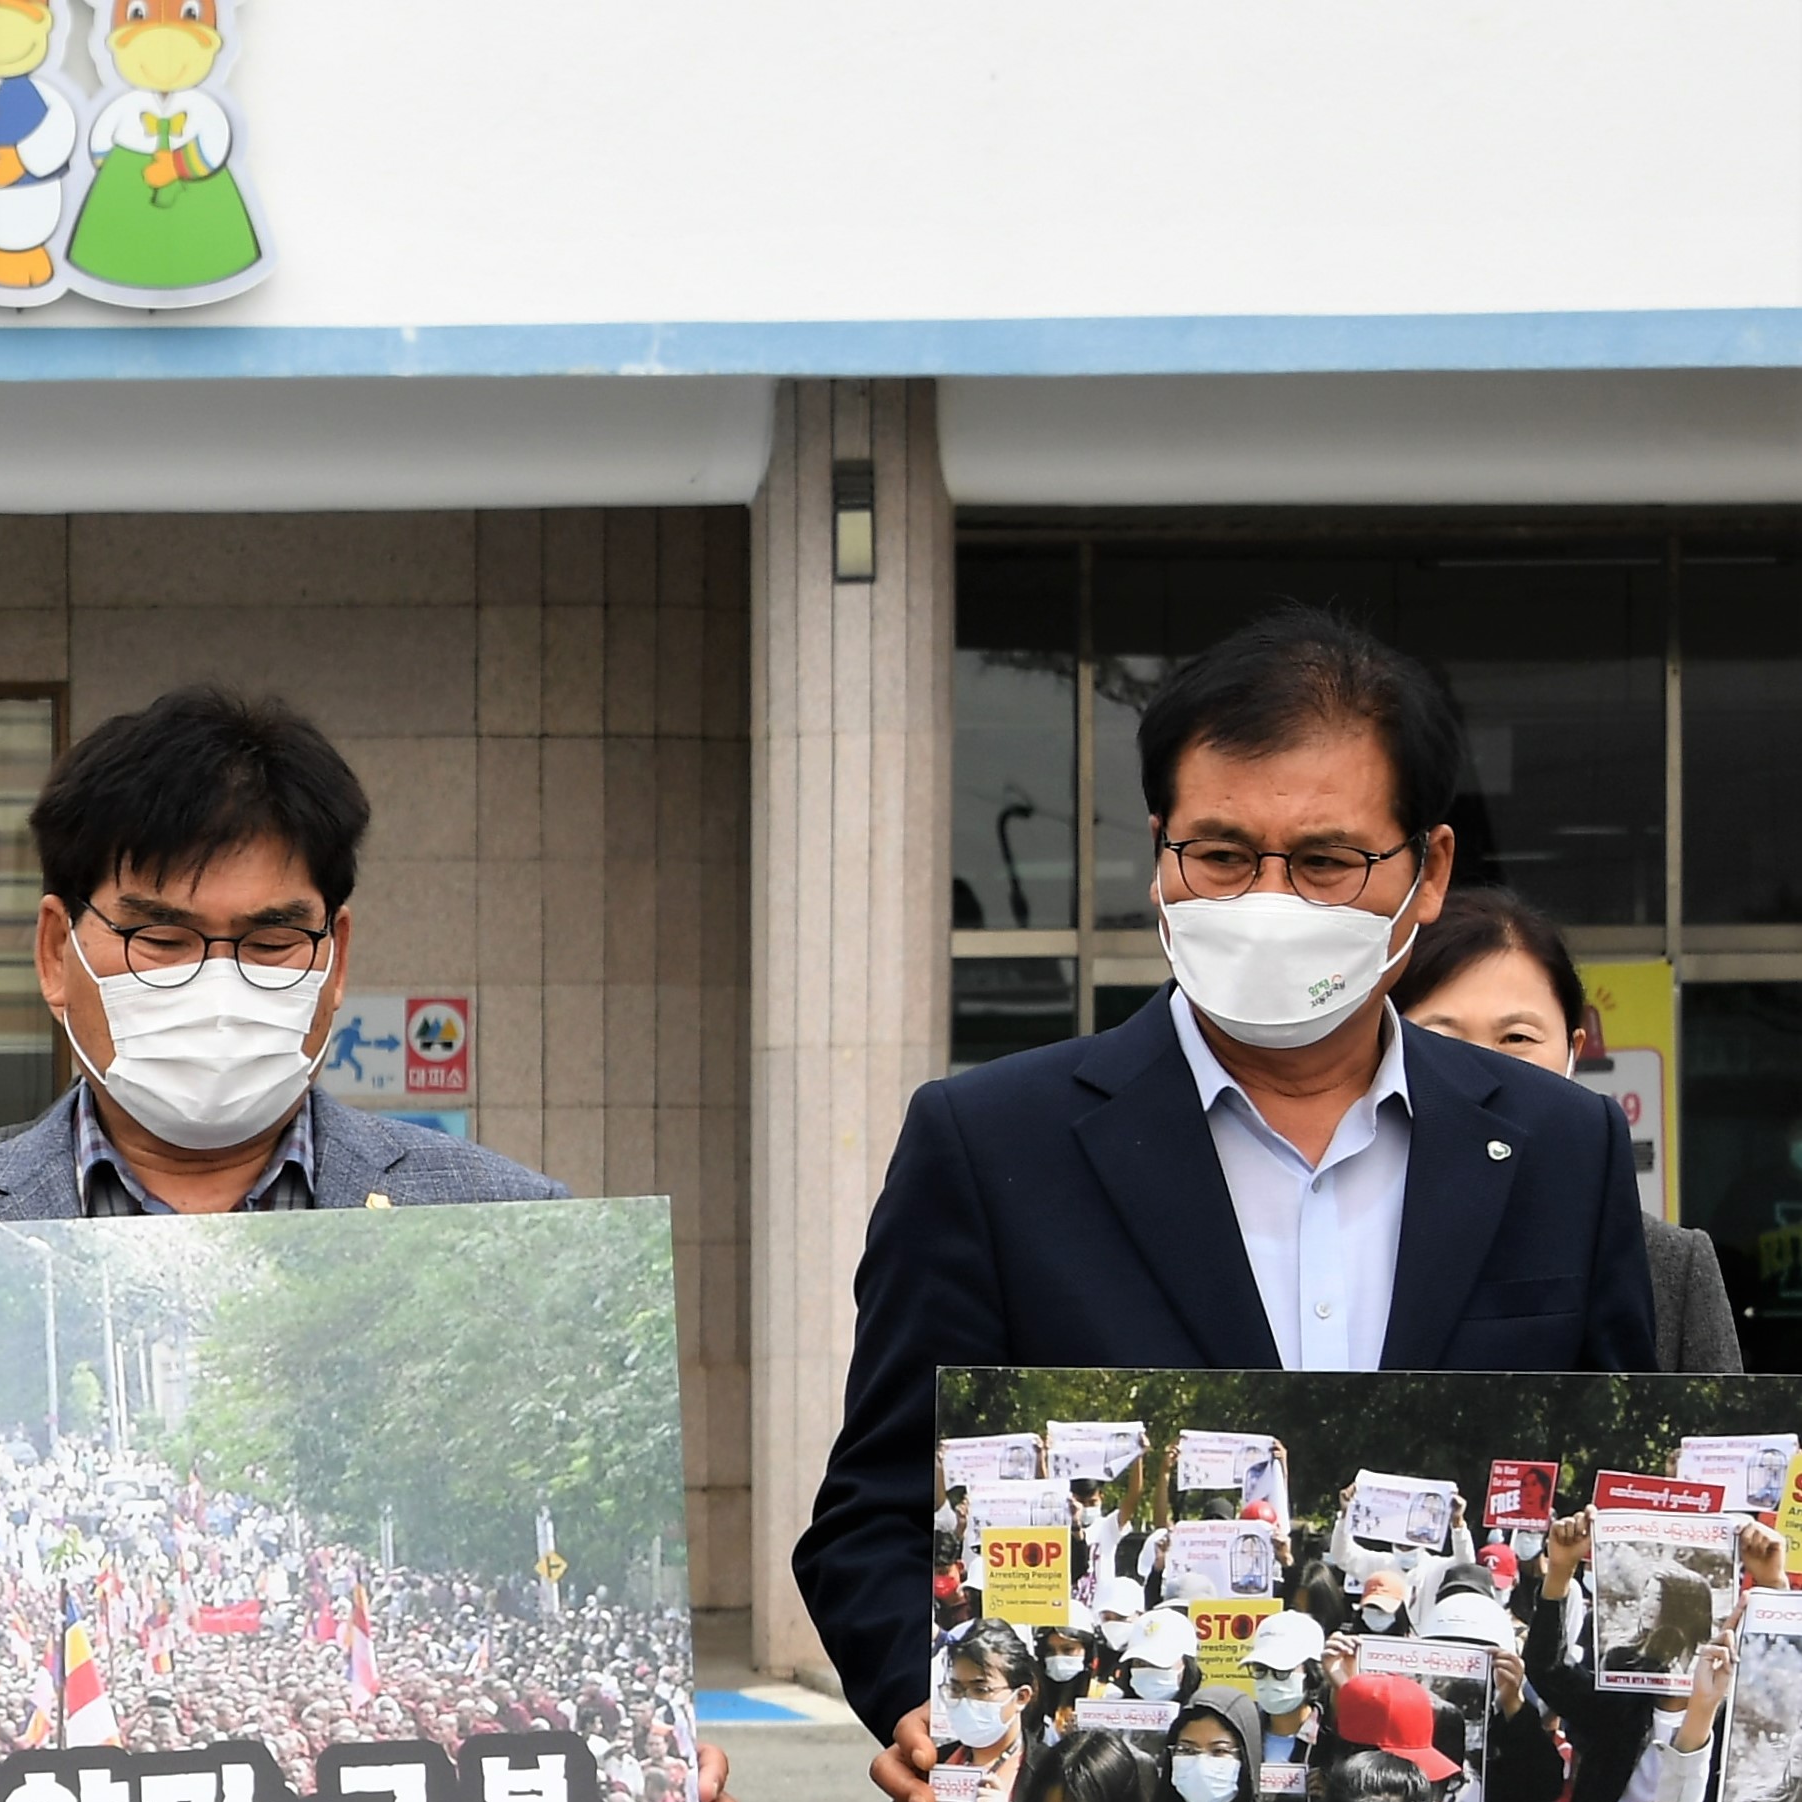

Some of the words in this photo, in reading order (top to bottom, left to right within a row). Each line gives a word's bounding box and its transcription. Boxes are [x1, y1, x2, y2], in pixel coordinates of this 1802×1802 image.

[408, 1067, 463, 1089] 대피소
[1490, 1488, 1522, 1516] FREE
[988, 1541, 1063, 1568] STOP
[989, 1571, 1030, 1581] Arresting
[1031, 1571, 1062, 1580] People
